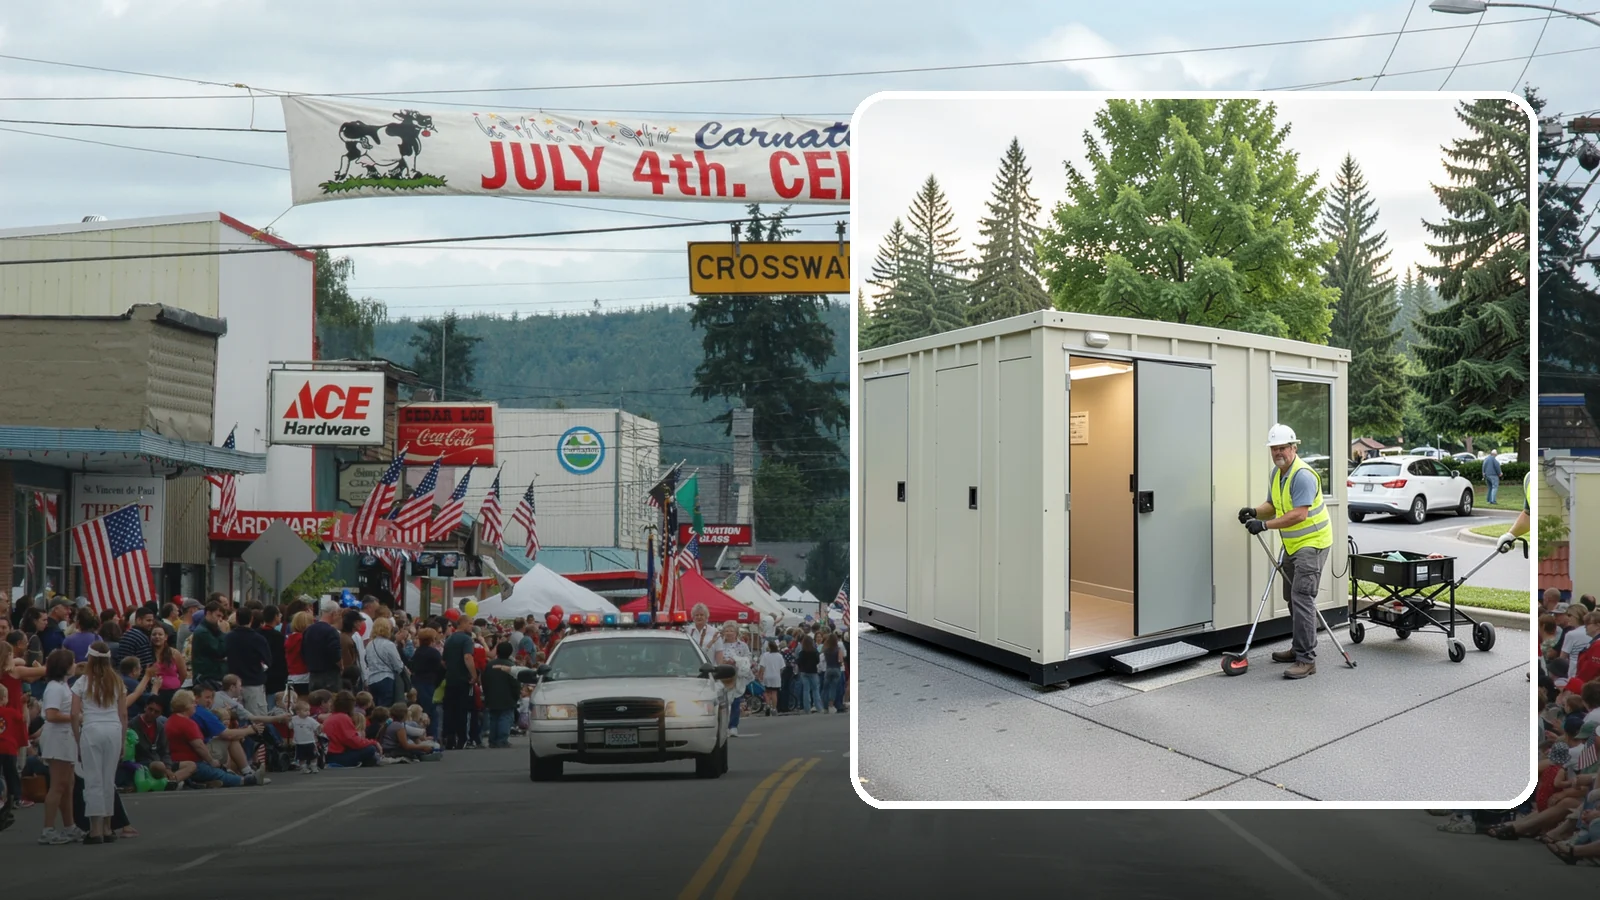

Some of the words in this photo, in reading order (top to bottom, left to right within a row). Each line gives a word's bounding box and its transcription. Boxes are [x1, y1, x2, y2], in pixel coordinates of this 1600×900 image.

[481, 140, 605, 192] JULY
[632, 150, 746, 198] 4th.
[697, 254, 850, 280] CROSSWA
[282, 379, 373, 419] ACE
[405, 408, 452, 422] CEDAR
[461, 409, 485, 422] LOG
[283, 421, 371, 436] Hardware
[416, 424, 477, 446] Coca-Cola
[95, 485, 124, 494] Vincent
[137, 486, 155, 495] Paul
[688, 526, 741, 535] CRNATION
[699, 535, 730, 543] GLASS
